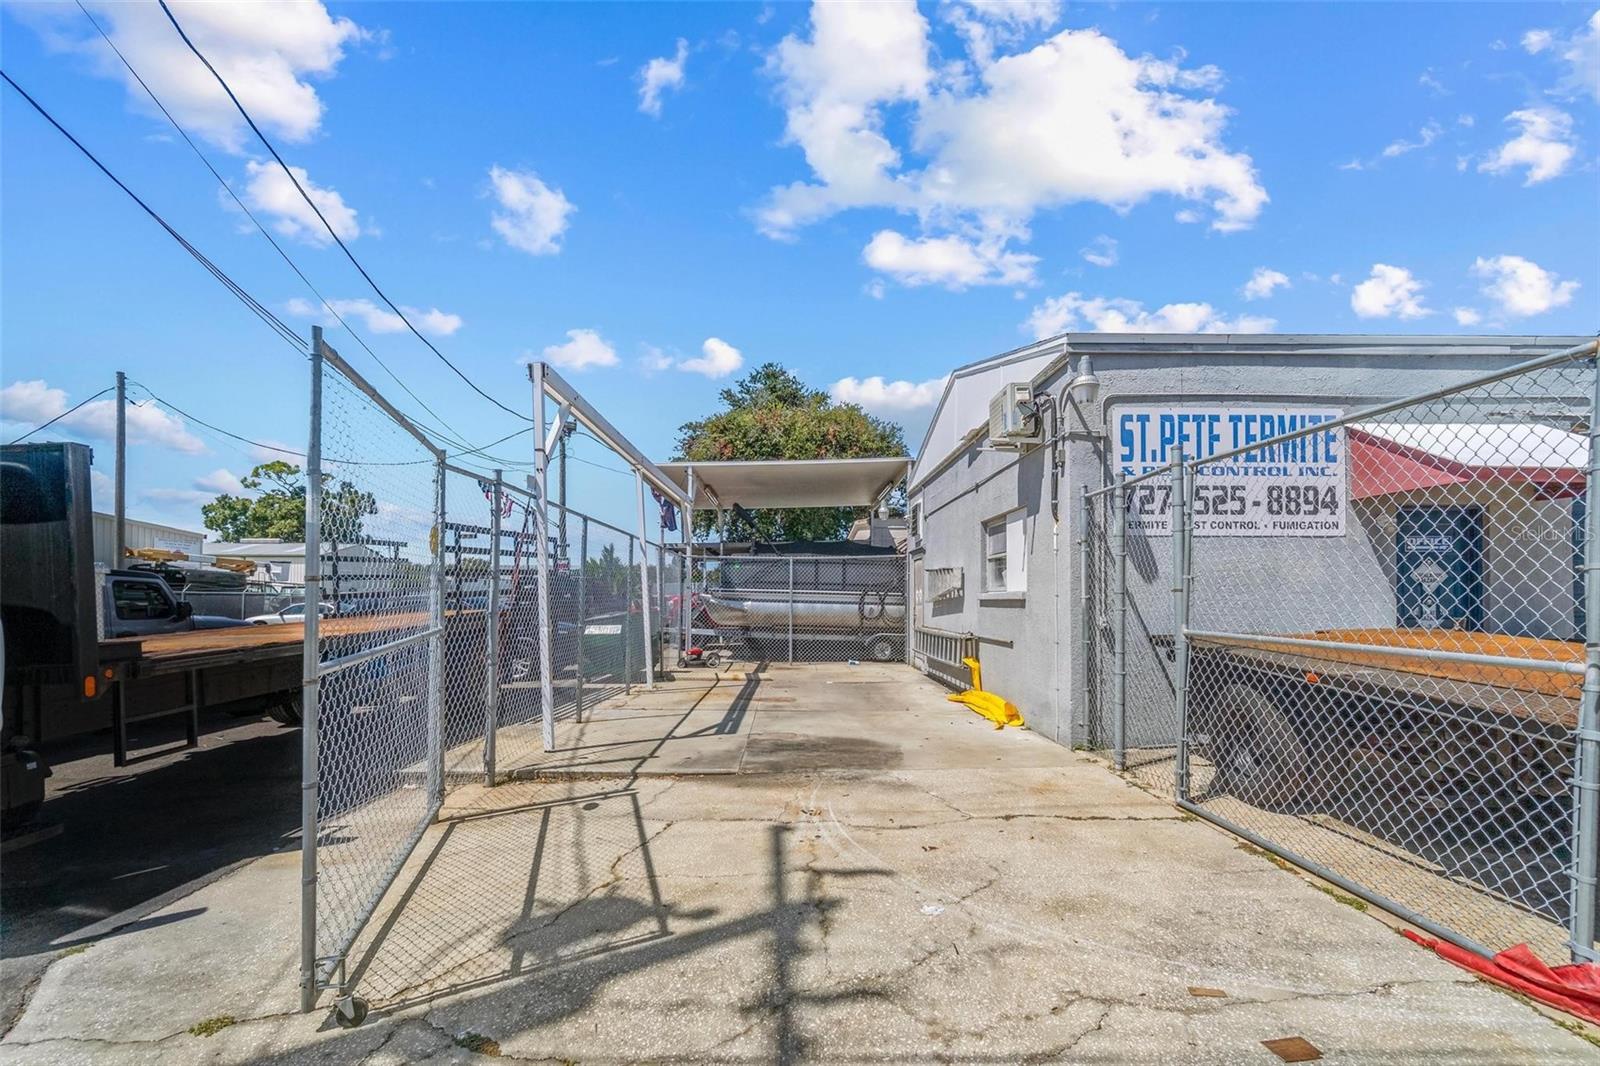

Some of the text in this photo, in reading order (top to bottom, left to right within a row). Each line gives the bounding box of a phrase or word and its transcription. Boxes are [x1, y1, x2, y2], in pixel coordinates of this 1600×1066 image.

[1229, 414, 1338, 463] TERMITE
[1121, 466, 1136, 476] &
[1199, 466, 1292, 477] CONTROL
[1299, 466, 1338, 477] INC.
[1128, 521, 1168, 530] ERMITE
[1210, 521, 1260, 530] CONTROL
[1273, 521, 1339, 530] FUMIGATION
